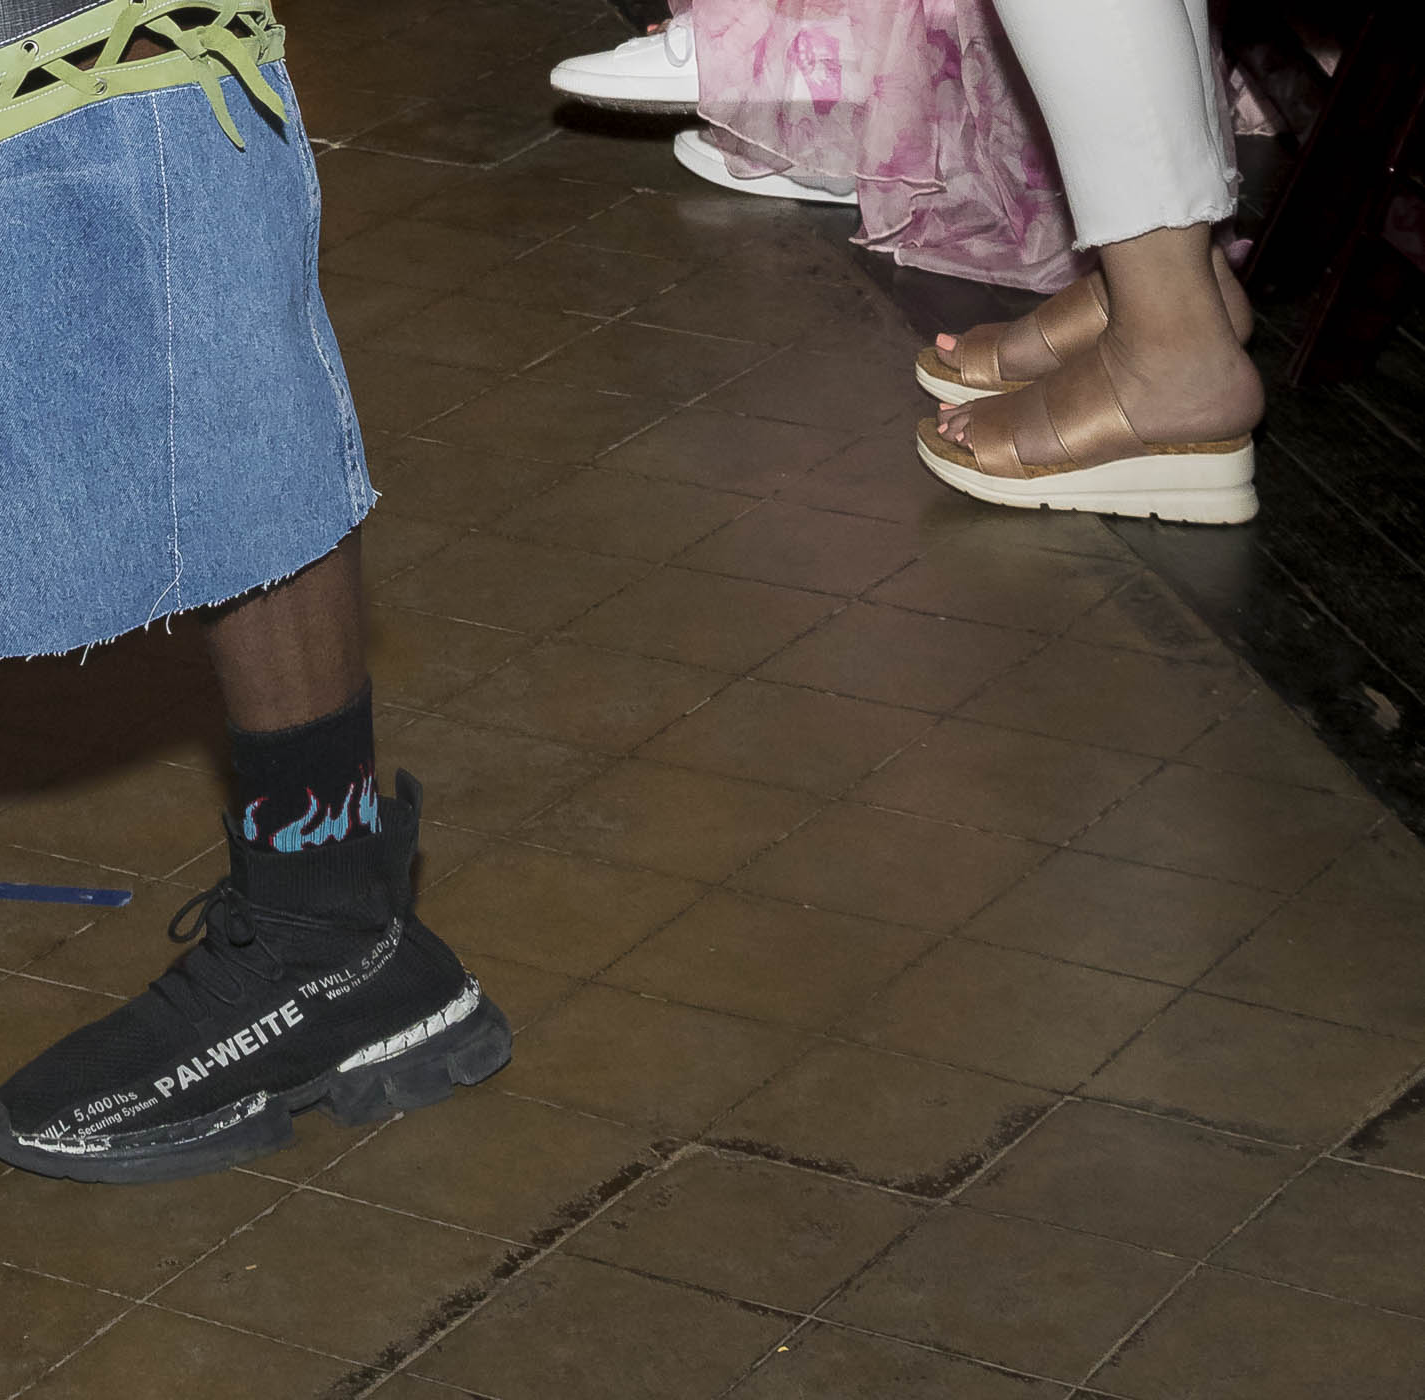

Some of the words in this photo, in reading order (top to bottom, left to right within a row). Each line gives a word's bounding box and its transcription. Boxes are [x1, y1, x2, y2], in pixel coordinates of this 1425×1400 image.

[153, 999, 304, 1098] PAI-WEITE
[298, 981, 320, 999] TM
[318, 969, 356, 989] WILL
[74, 1097, 113, 1122] 5,400
[113, 1091, 138, 1105] lbs
[78, 1111, 123, 1139] Securing
[122, 1097, 158, 1117] System
